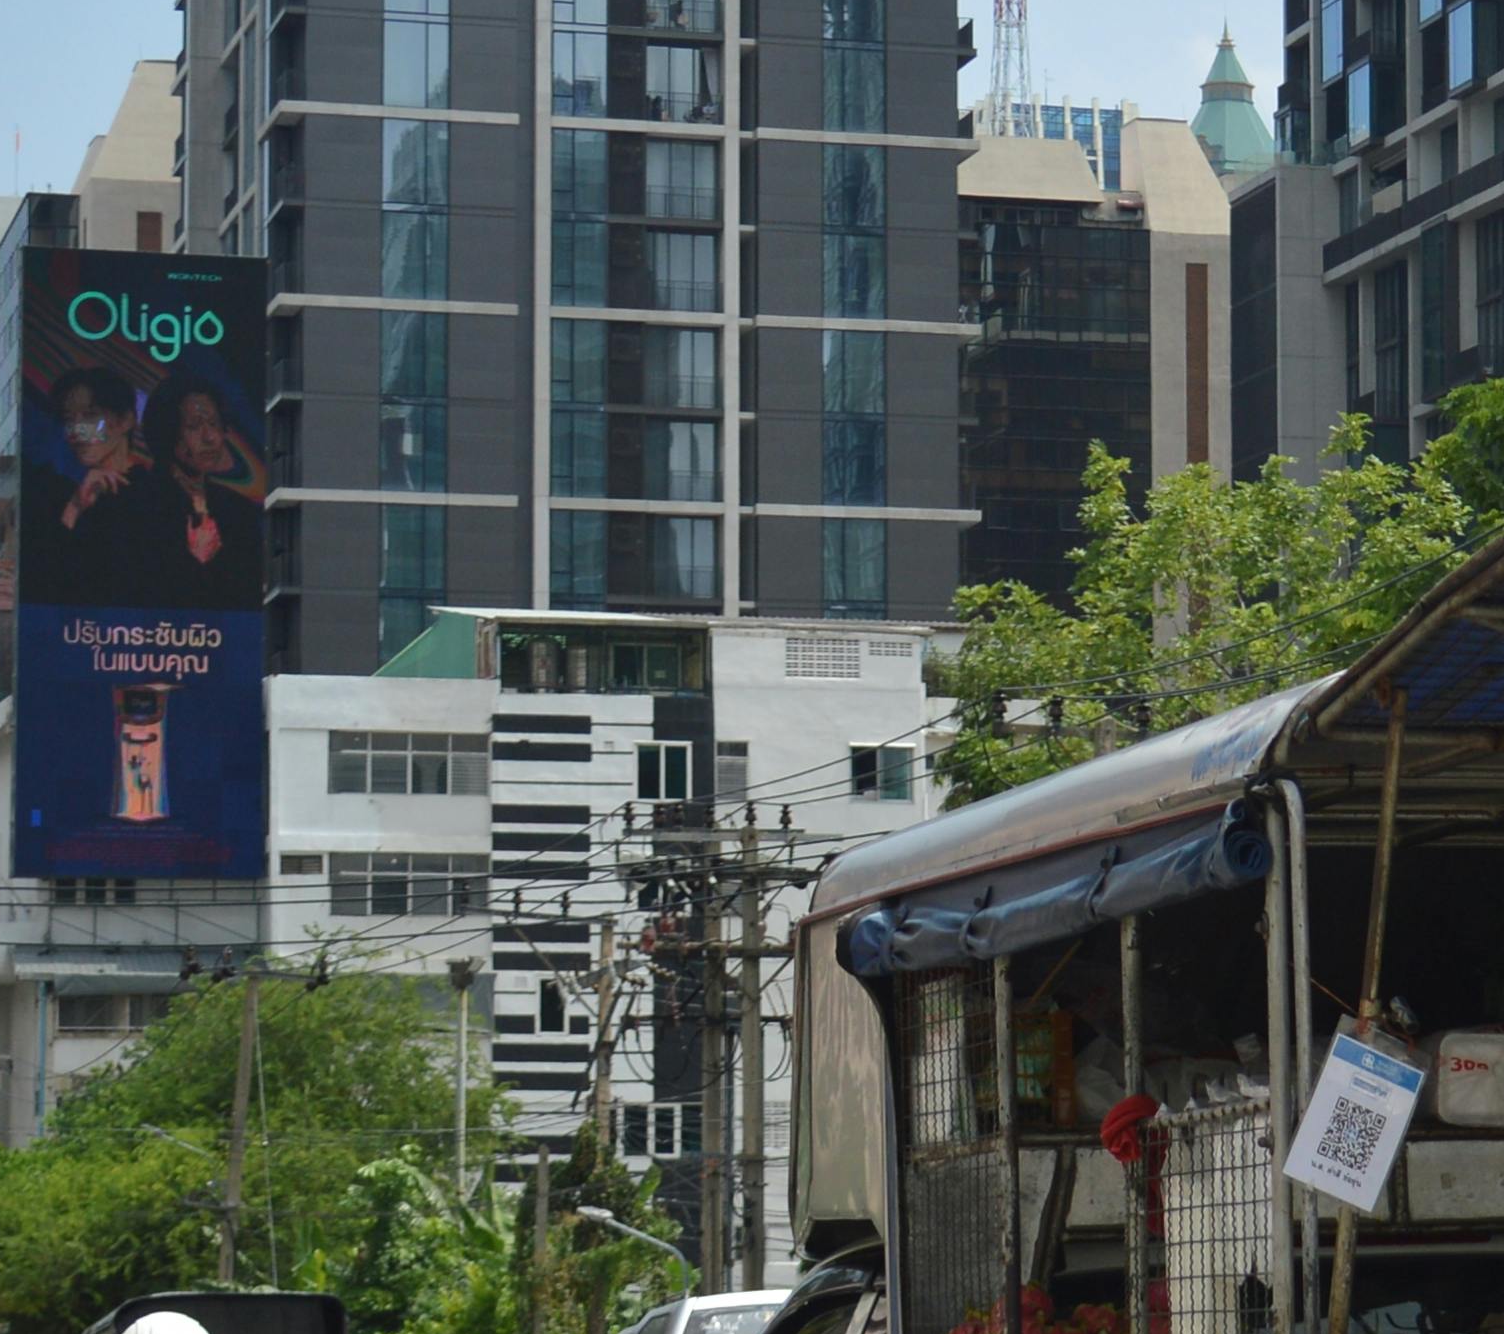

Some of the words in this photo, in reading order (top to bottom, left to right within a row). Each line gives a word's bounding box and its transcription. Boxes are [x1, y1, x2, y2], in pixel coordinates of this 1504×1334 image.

[68, 291, 224, 363] Oligio
[63, 619, 222, 648] ปรับกระชับผิว
[91, 645, 209, 680] ในแบบคุณ
